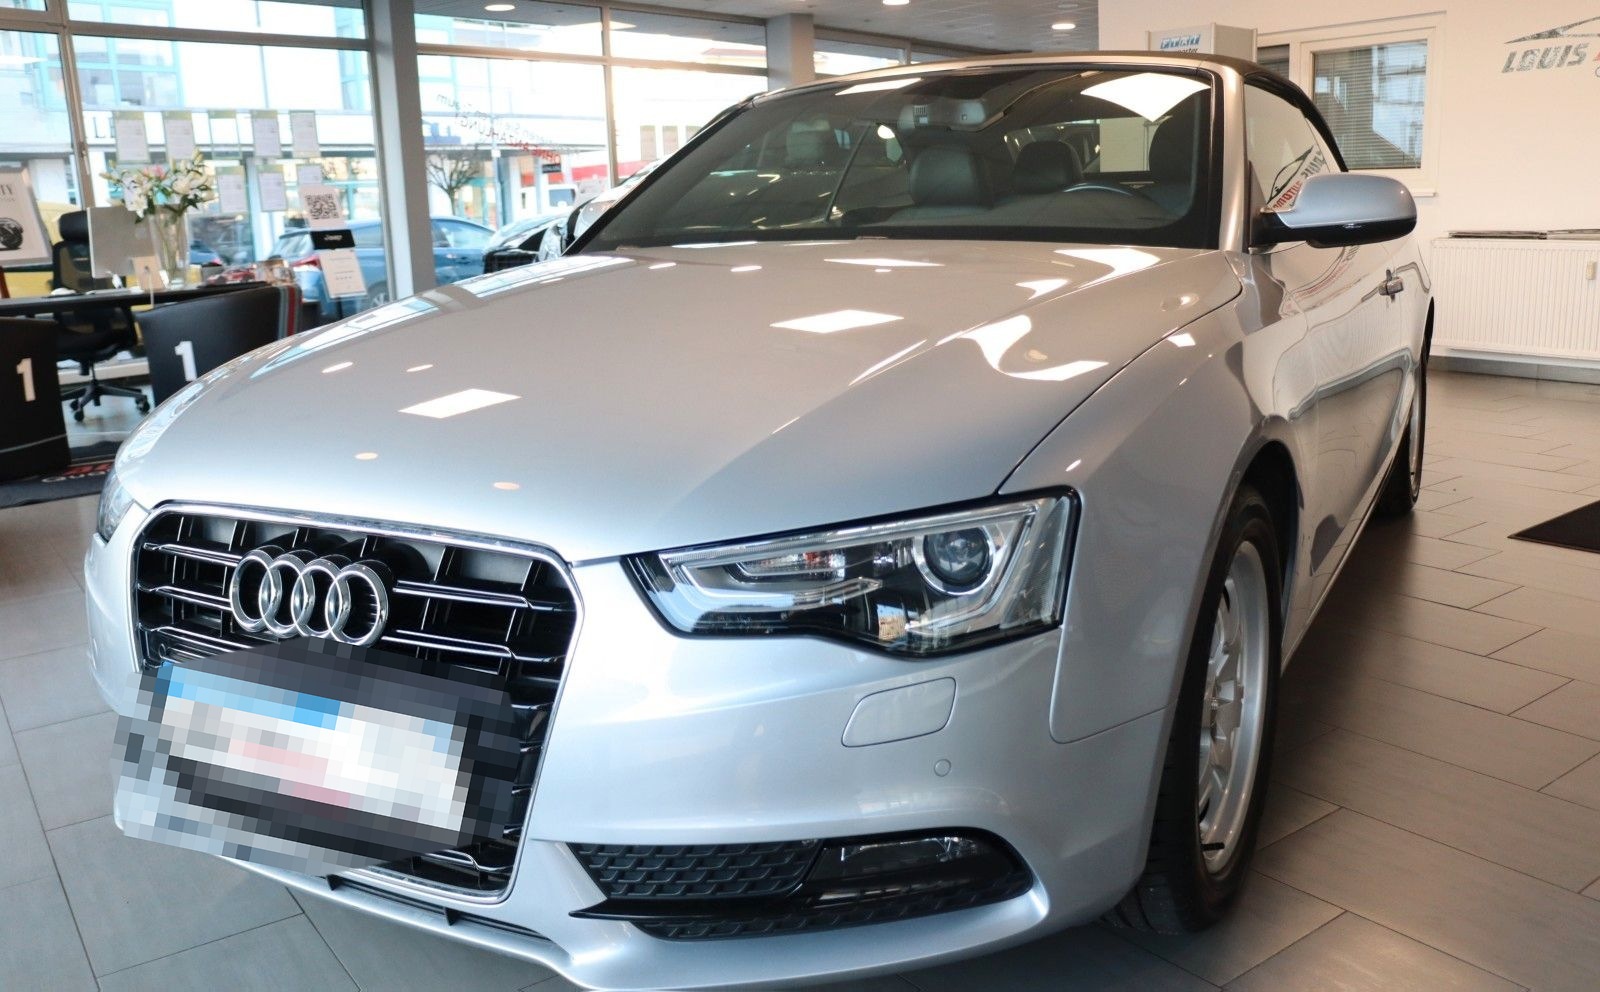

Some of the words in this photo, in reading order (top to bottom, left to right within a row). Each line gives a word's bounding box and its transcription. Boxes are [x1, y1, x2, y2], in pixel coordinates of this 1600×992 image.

[1501, 43, 1589, 73] LOUIS
[16, 358, 36, 401] 1
[174, 341, 197, 382] 1
